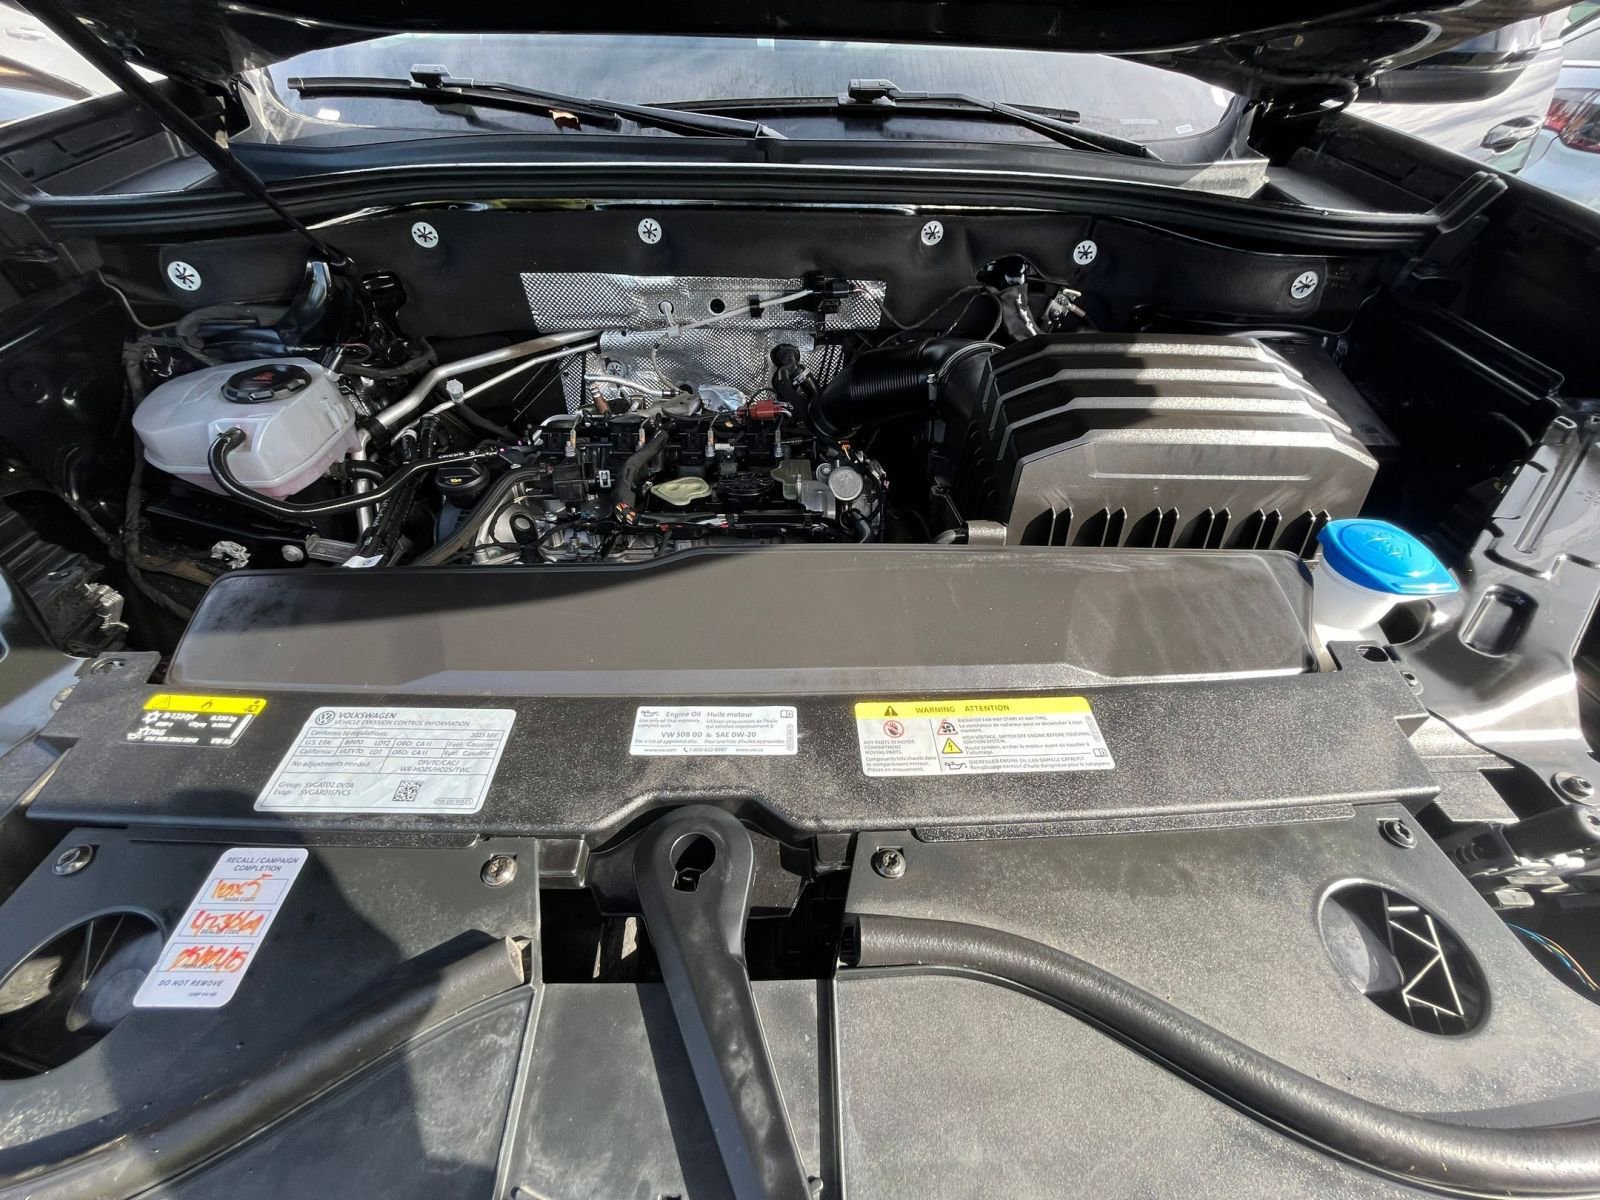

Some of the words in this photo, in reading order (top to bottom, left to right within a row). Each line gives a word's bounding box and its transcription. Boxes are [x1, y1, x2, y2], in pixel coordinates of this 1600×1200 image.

[915, 706, 956, 714] WARNING
[965, 704, 1010, 712] ATTENTION
[666, 711, 689, 719] Engine
[361, 719, 393, 727] EMISSION
[302, 760, 344, 769] adjustments
